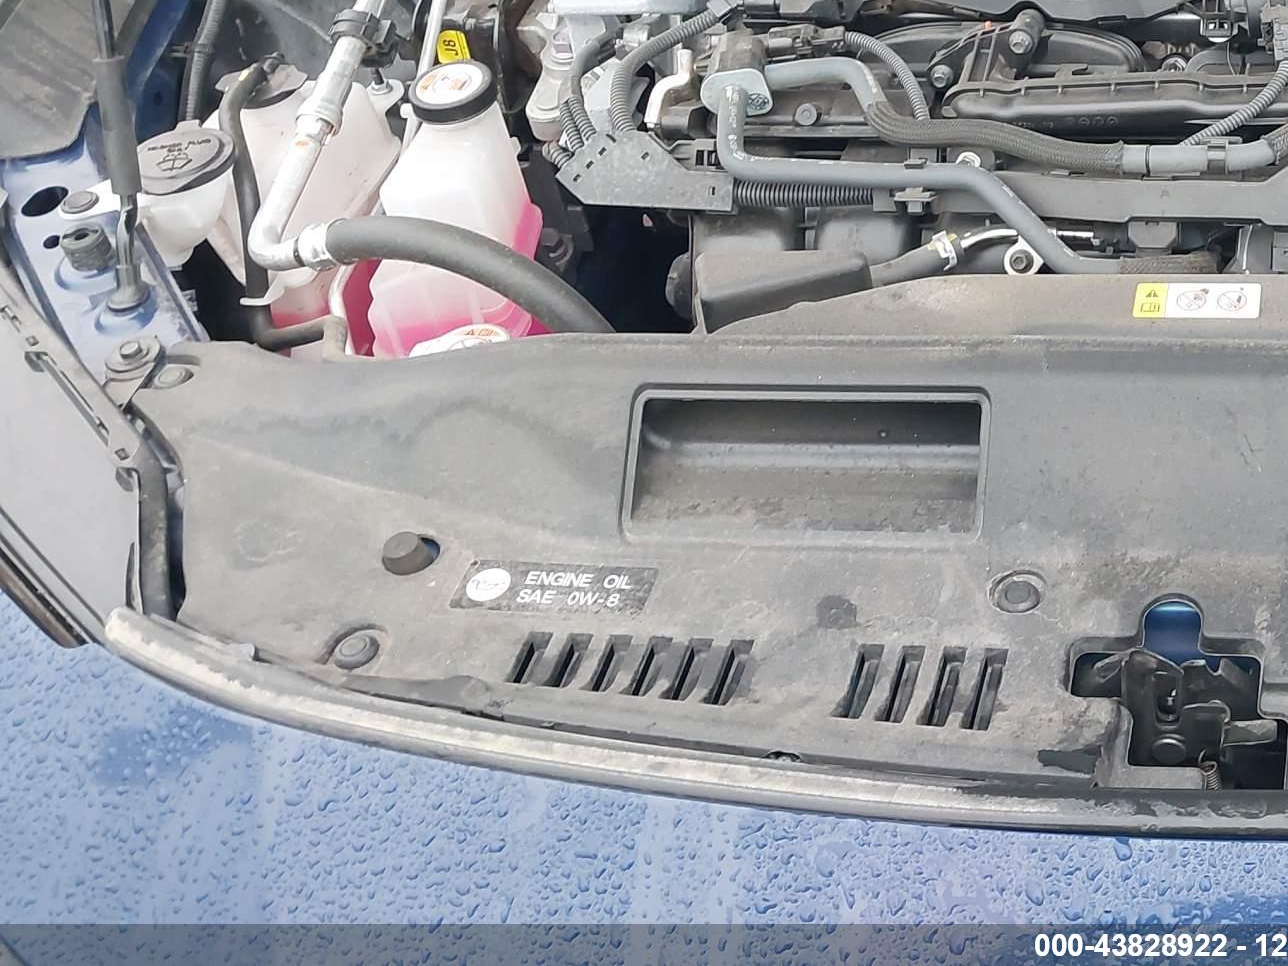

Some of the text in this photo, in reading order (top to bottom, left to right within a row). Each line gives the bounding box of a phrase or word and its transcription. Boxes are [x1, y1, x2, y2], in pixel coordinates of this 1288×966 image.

[524, 570, 633, 589] ENGINE OIL
[516, 588, 621, 607] SAE 0W-8
